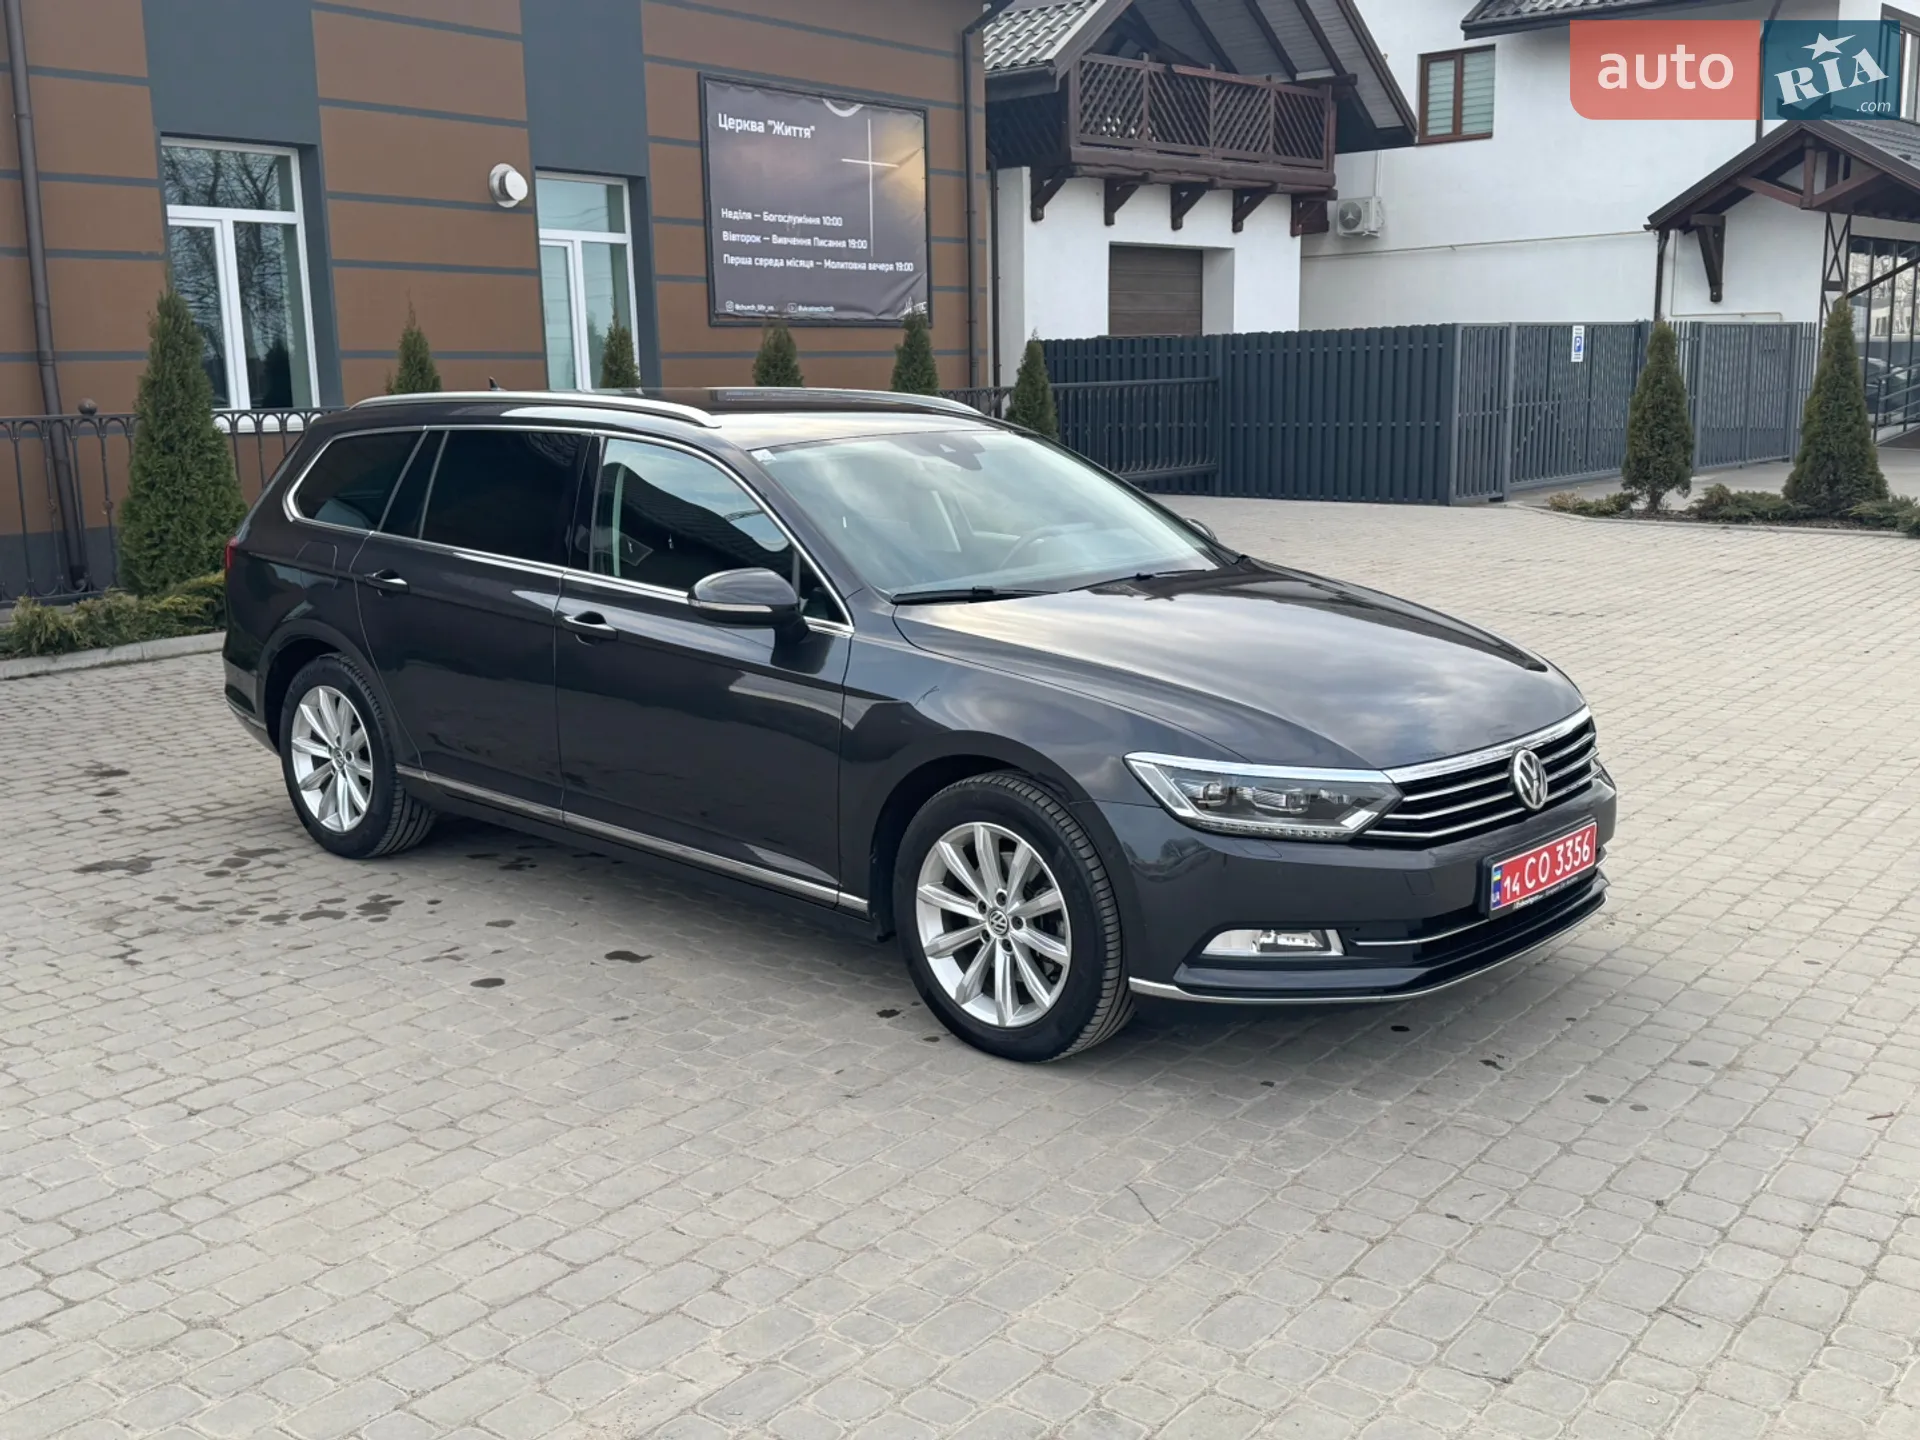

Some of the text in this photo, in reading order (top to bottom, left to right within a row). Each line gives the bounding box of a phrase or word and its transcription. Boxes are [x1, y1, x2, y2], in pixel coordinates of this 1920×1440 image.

[718, 112, 815, 138] Церква "Життя"
[721, 208, 752, 220] Неділя
[762, 211, 821, 226] Богослужіння
[822, 216, 843, 227] 10:00
[722, 230, 762, 244] Вівторок
[772, 234, 812, 246] Вивчення
[813, 236, 847, 248] Писання
[848, 238, 868, 249] 19:00
[723, 253, 753, 266] Перша
[754, 257, 784, 268] середа
[786, 258, 815, 269] місяця
[824, 259, 867, 271] Молитовна
[1503, 871, 1520, 900] 14
[1524, 851, 1550, 889] CO
[1554, 830, 1591, 876] 3356
